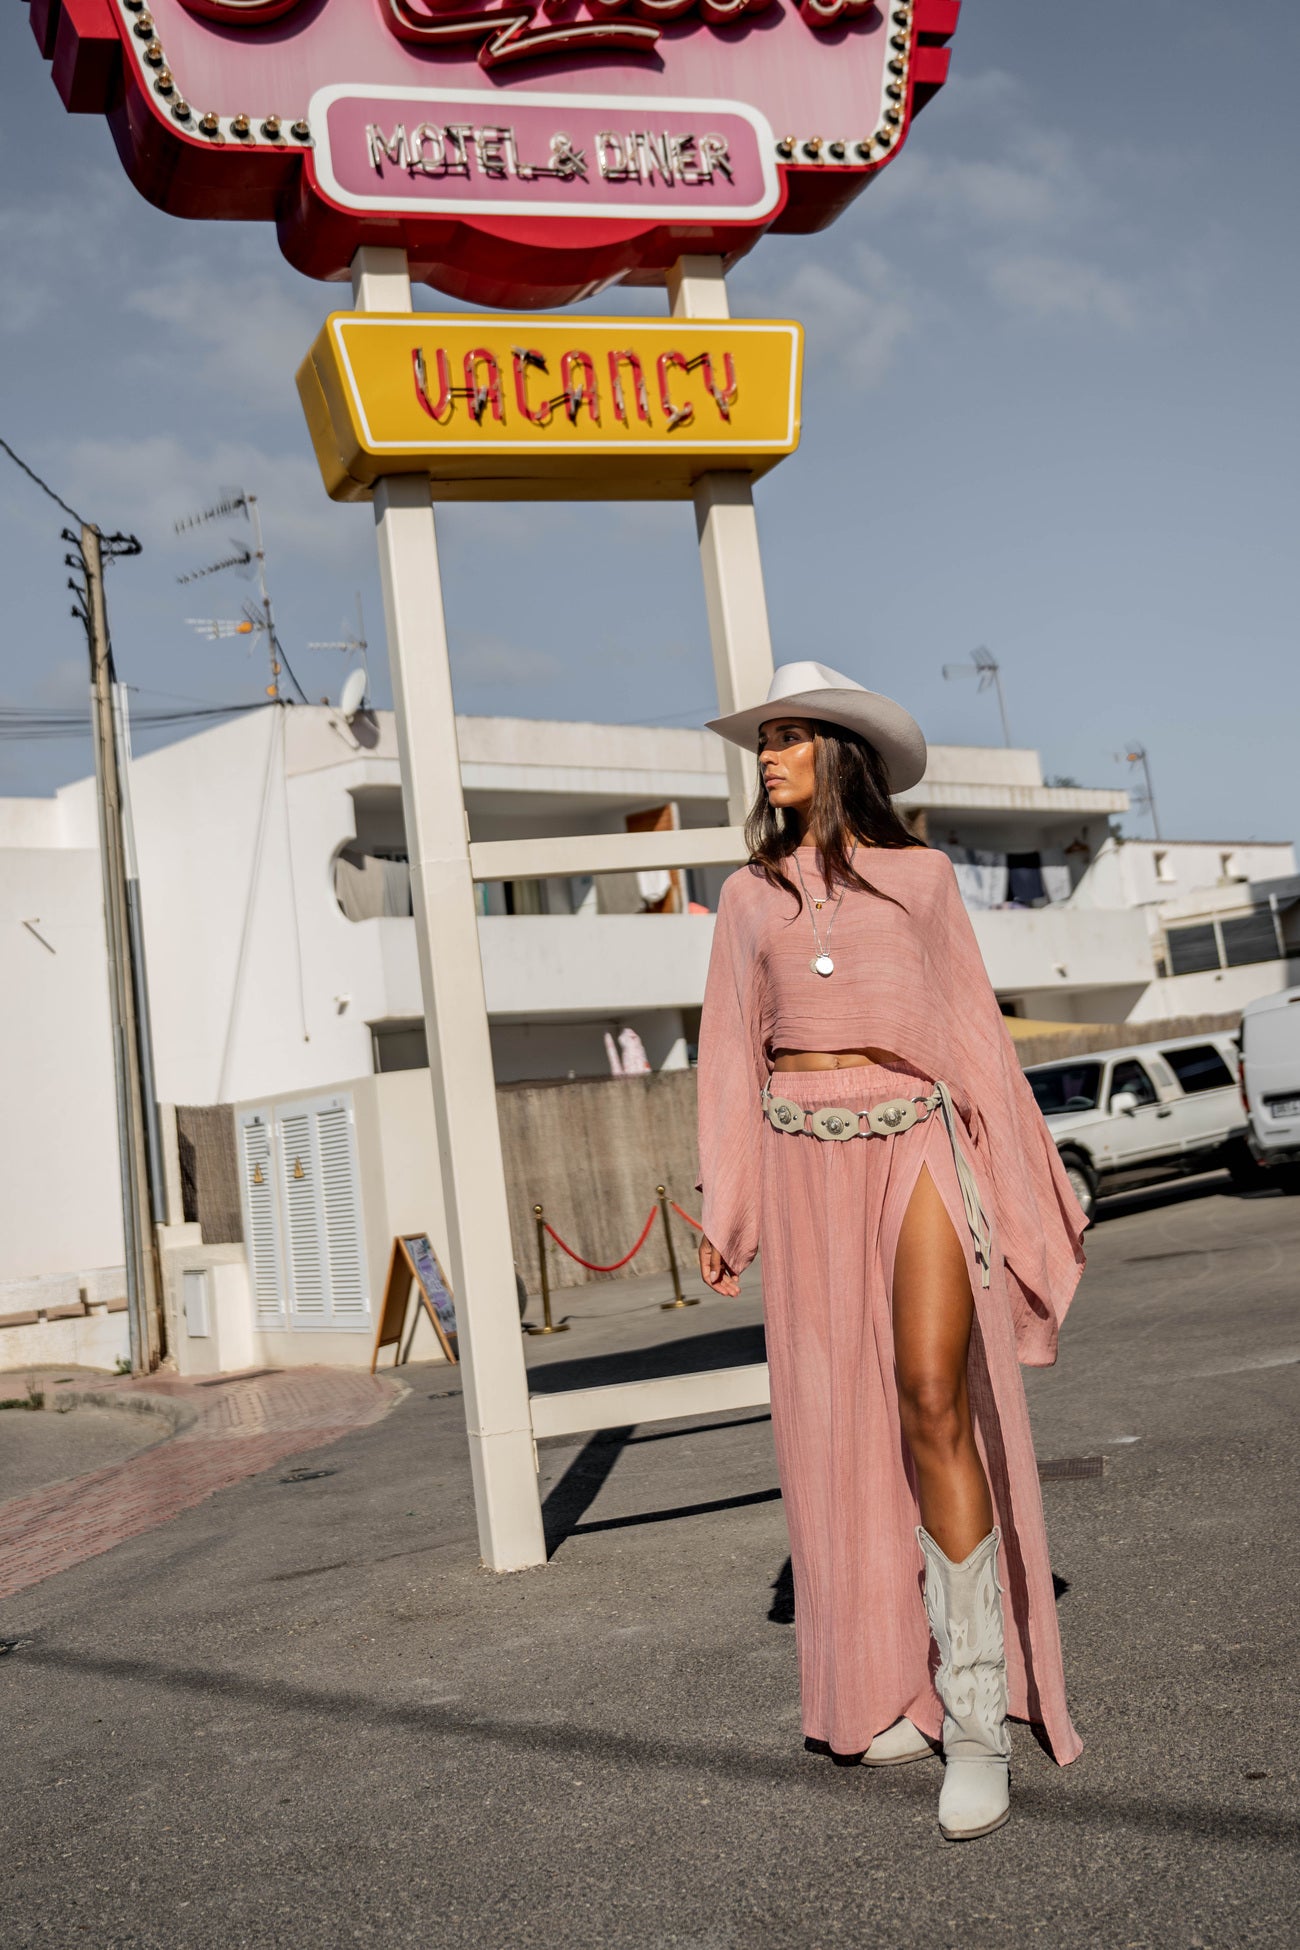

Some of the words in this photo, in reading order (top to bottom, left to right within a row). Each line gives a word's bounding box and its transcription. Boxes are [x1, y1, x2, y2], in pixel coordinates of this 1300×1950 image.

[364, 122, 534, 178] MOTEL
[548, 130, 590, 178] &
[594, 129, 735, 184] DINER
[411, 346, 738, 423] VACANCY
